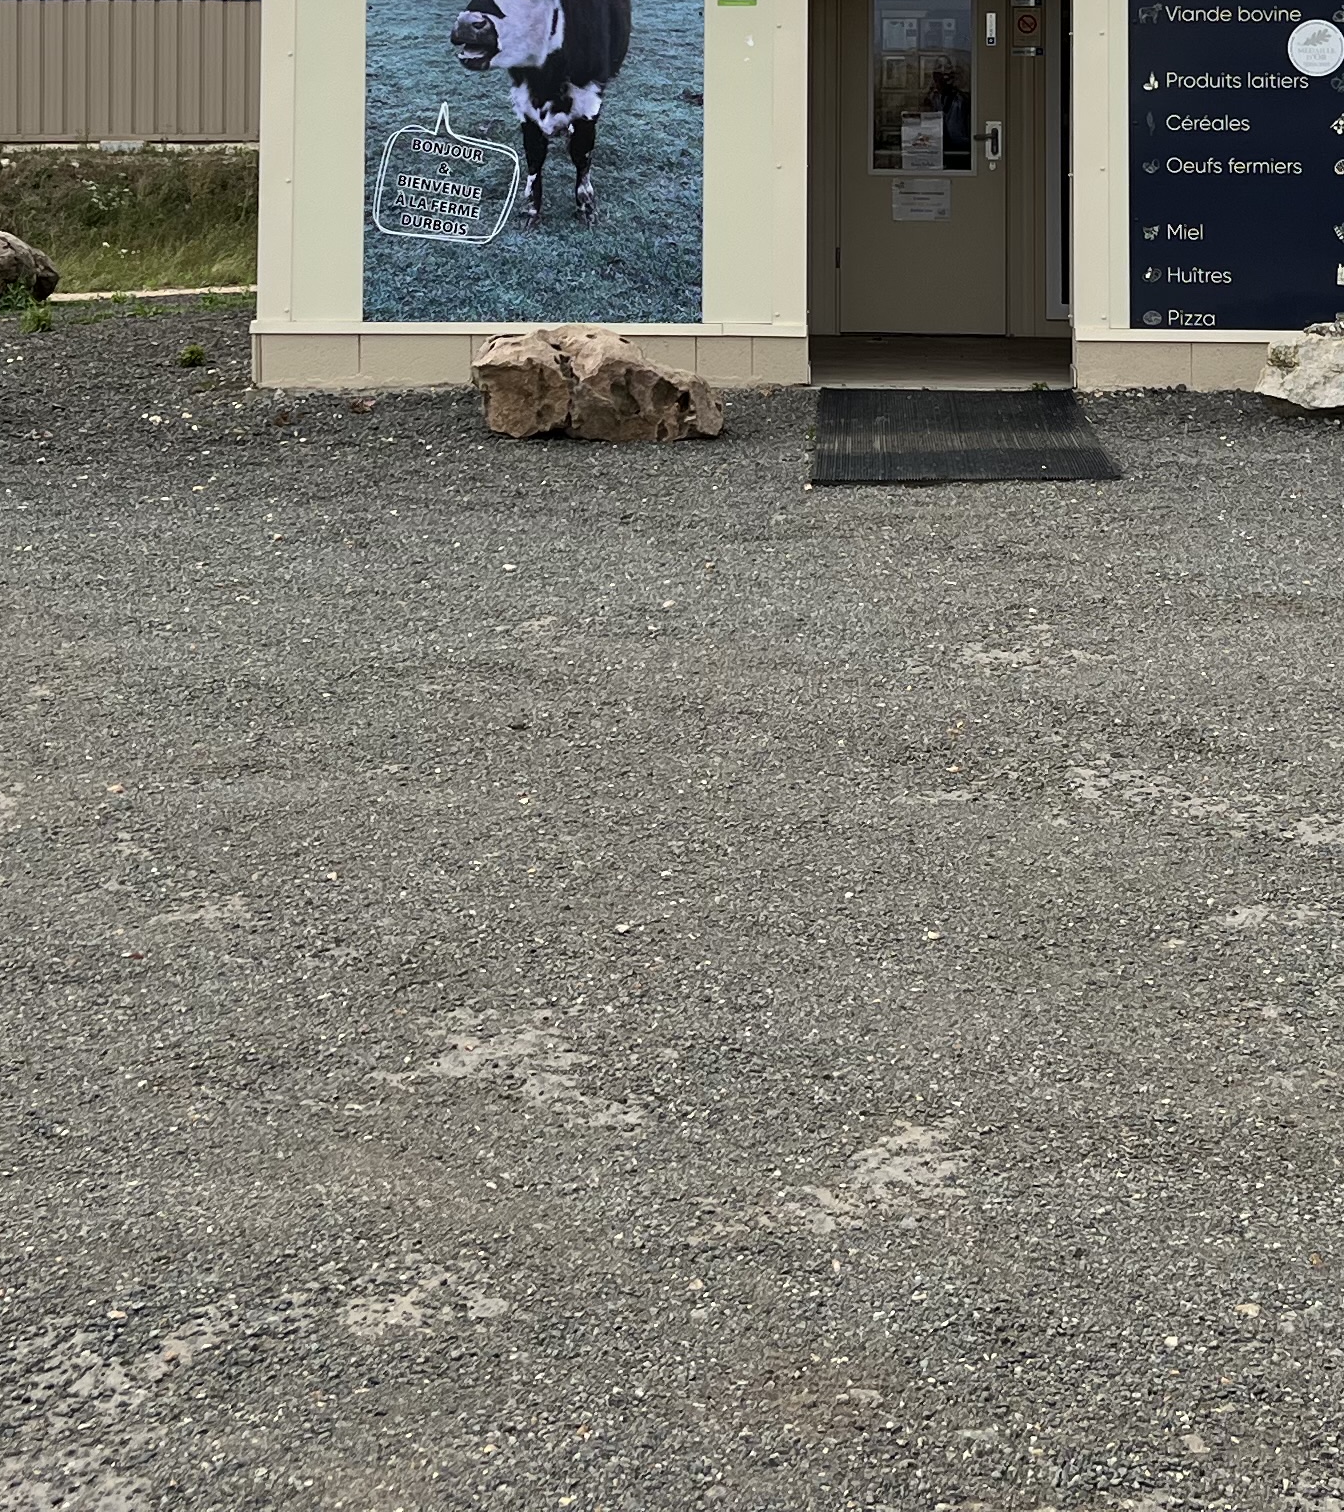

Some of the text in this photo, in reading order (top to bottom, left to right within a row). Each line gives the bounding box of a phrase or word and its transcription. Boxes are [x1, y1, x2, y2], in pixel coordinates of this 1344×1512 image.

[1165, 6, 1302, 22] Viande bovine
[1167, 72, 1309, 89] Produits laitiers
[1166, 115, 1250, 131] Céréales
[412, 139, 483, 161] BONJOUR
[438, 162, 450, 175] &
[1167, 157, 1302, 174] Oeufs fermiers
[398, 175, 481, 199] BIENVENUE
[409, 196, 427, 209] LA
[431, 200, 480, 219] FERME
[402, 214, 467, 235] DURBOIS
[1168, 224, 1203, 240] Miel
[1168, 267, 1232, 283] Huîtres
[1169, 310, 1215, 326] Pizza
